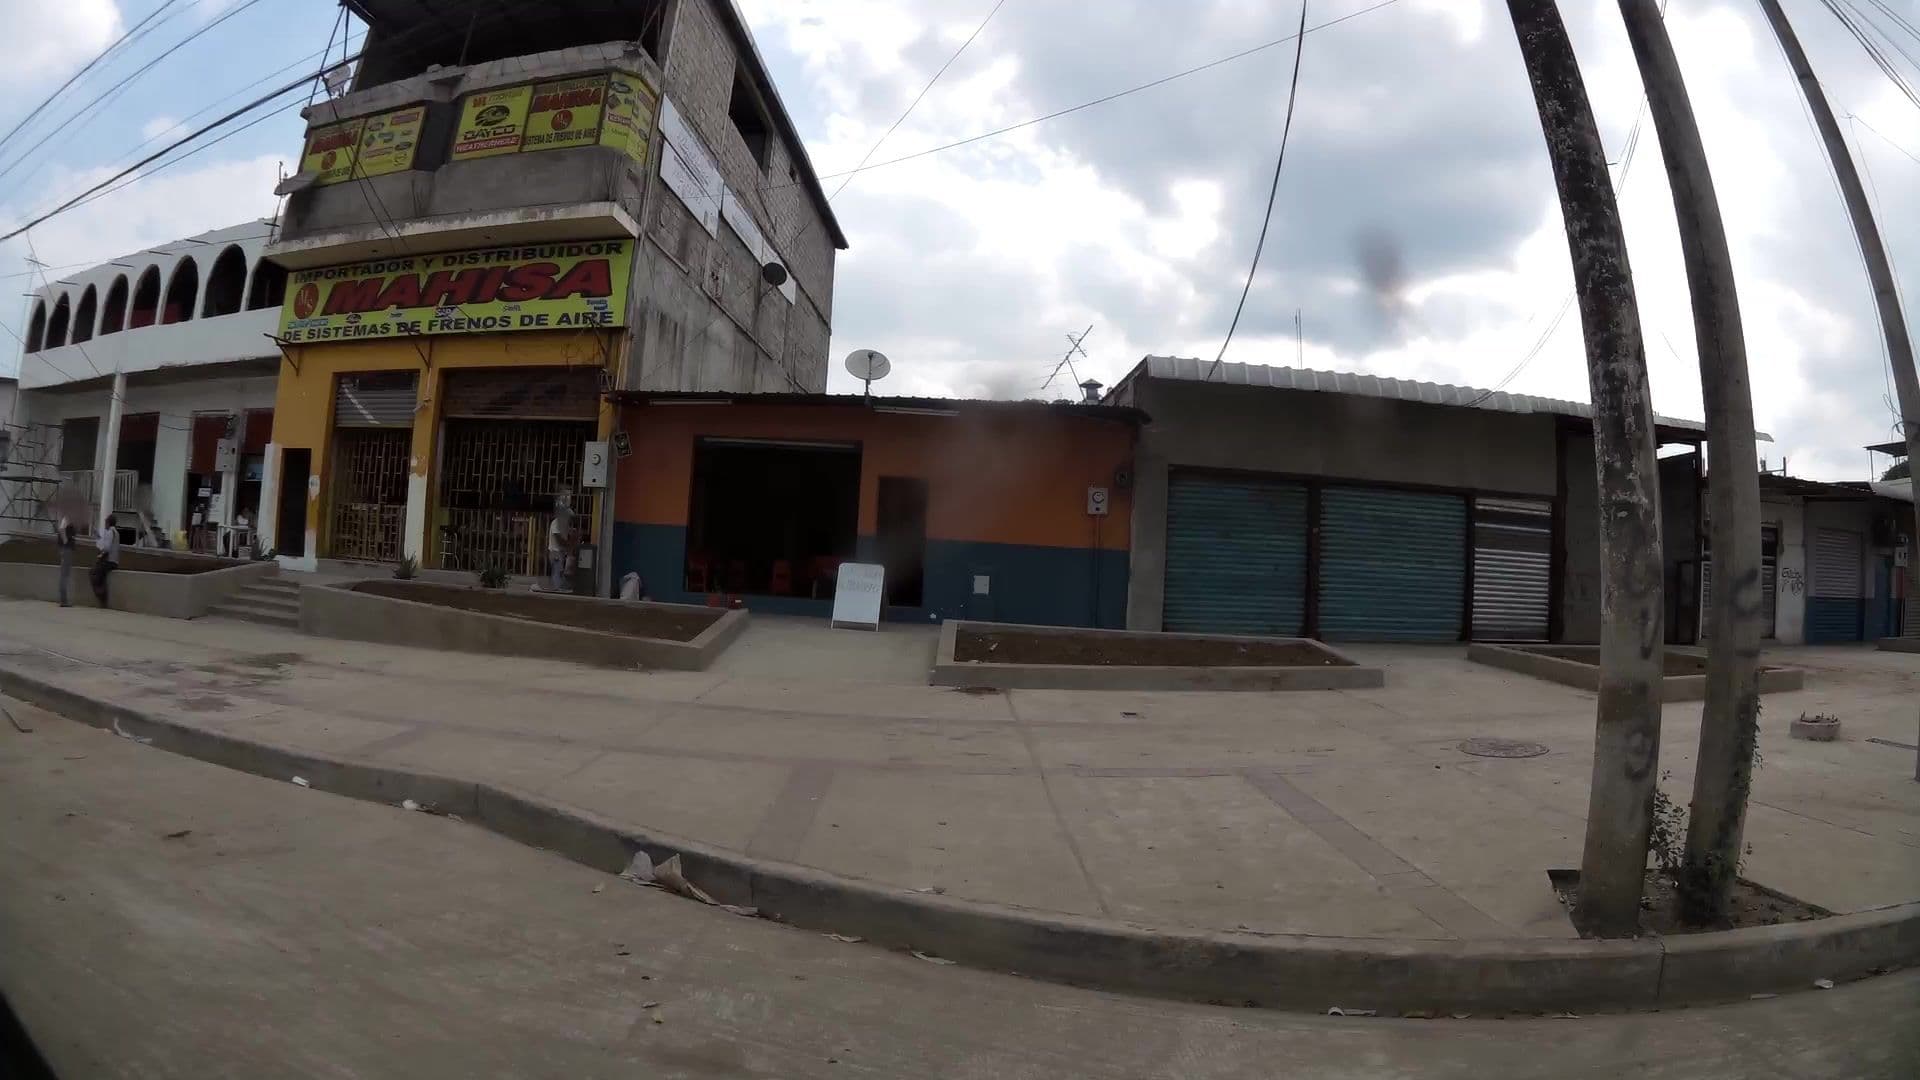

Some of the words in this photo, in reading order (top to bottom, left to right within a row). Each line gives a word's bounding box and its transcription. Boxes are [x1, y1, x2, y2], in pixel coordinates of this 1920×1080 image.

[463, 124, 516, 140] DAYCO
[295, 259, 414, 284] IMPORTADOR
[423, 256, 434, 268] Y
[443, 242, 622, 267] DISTRIBUIDOR
[322, 259, 612, 316] MAHISA
[284, 328, 302, 341] DE
[307, 322, 390, 339] SISTEMAS
[397, 320, 421, 334] DE
[428, 315, 511, 331] FRENOS
[519, 313, 549, 327] DE
[557, 311, 614, 325] AIRE
